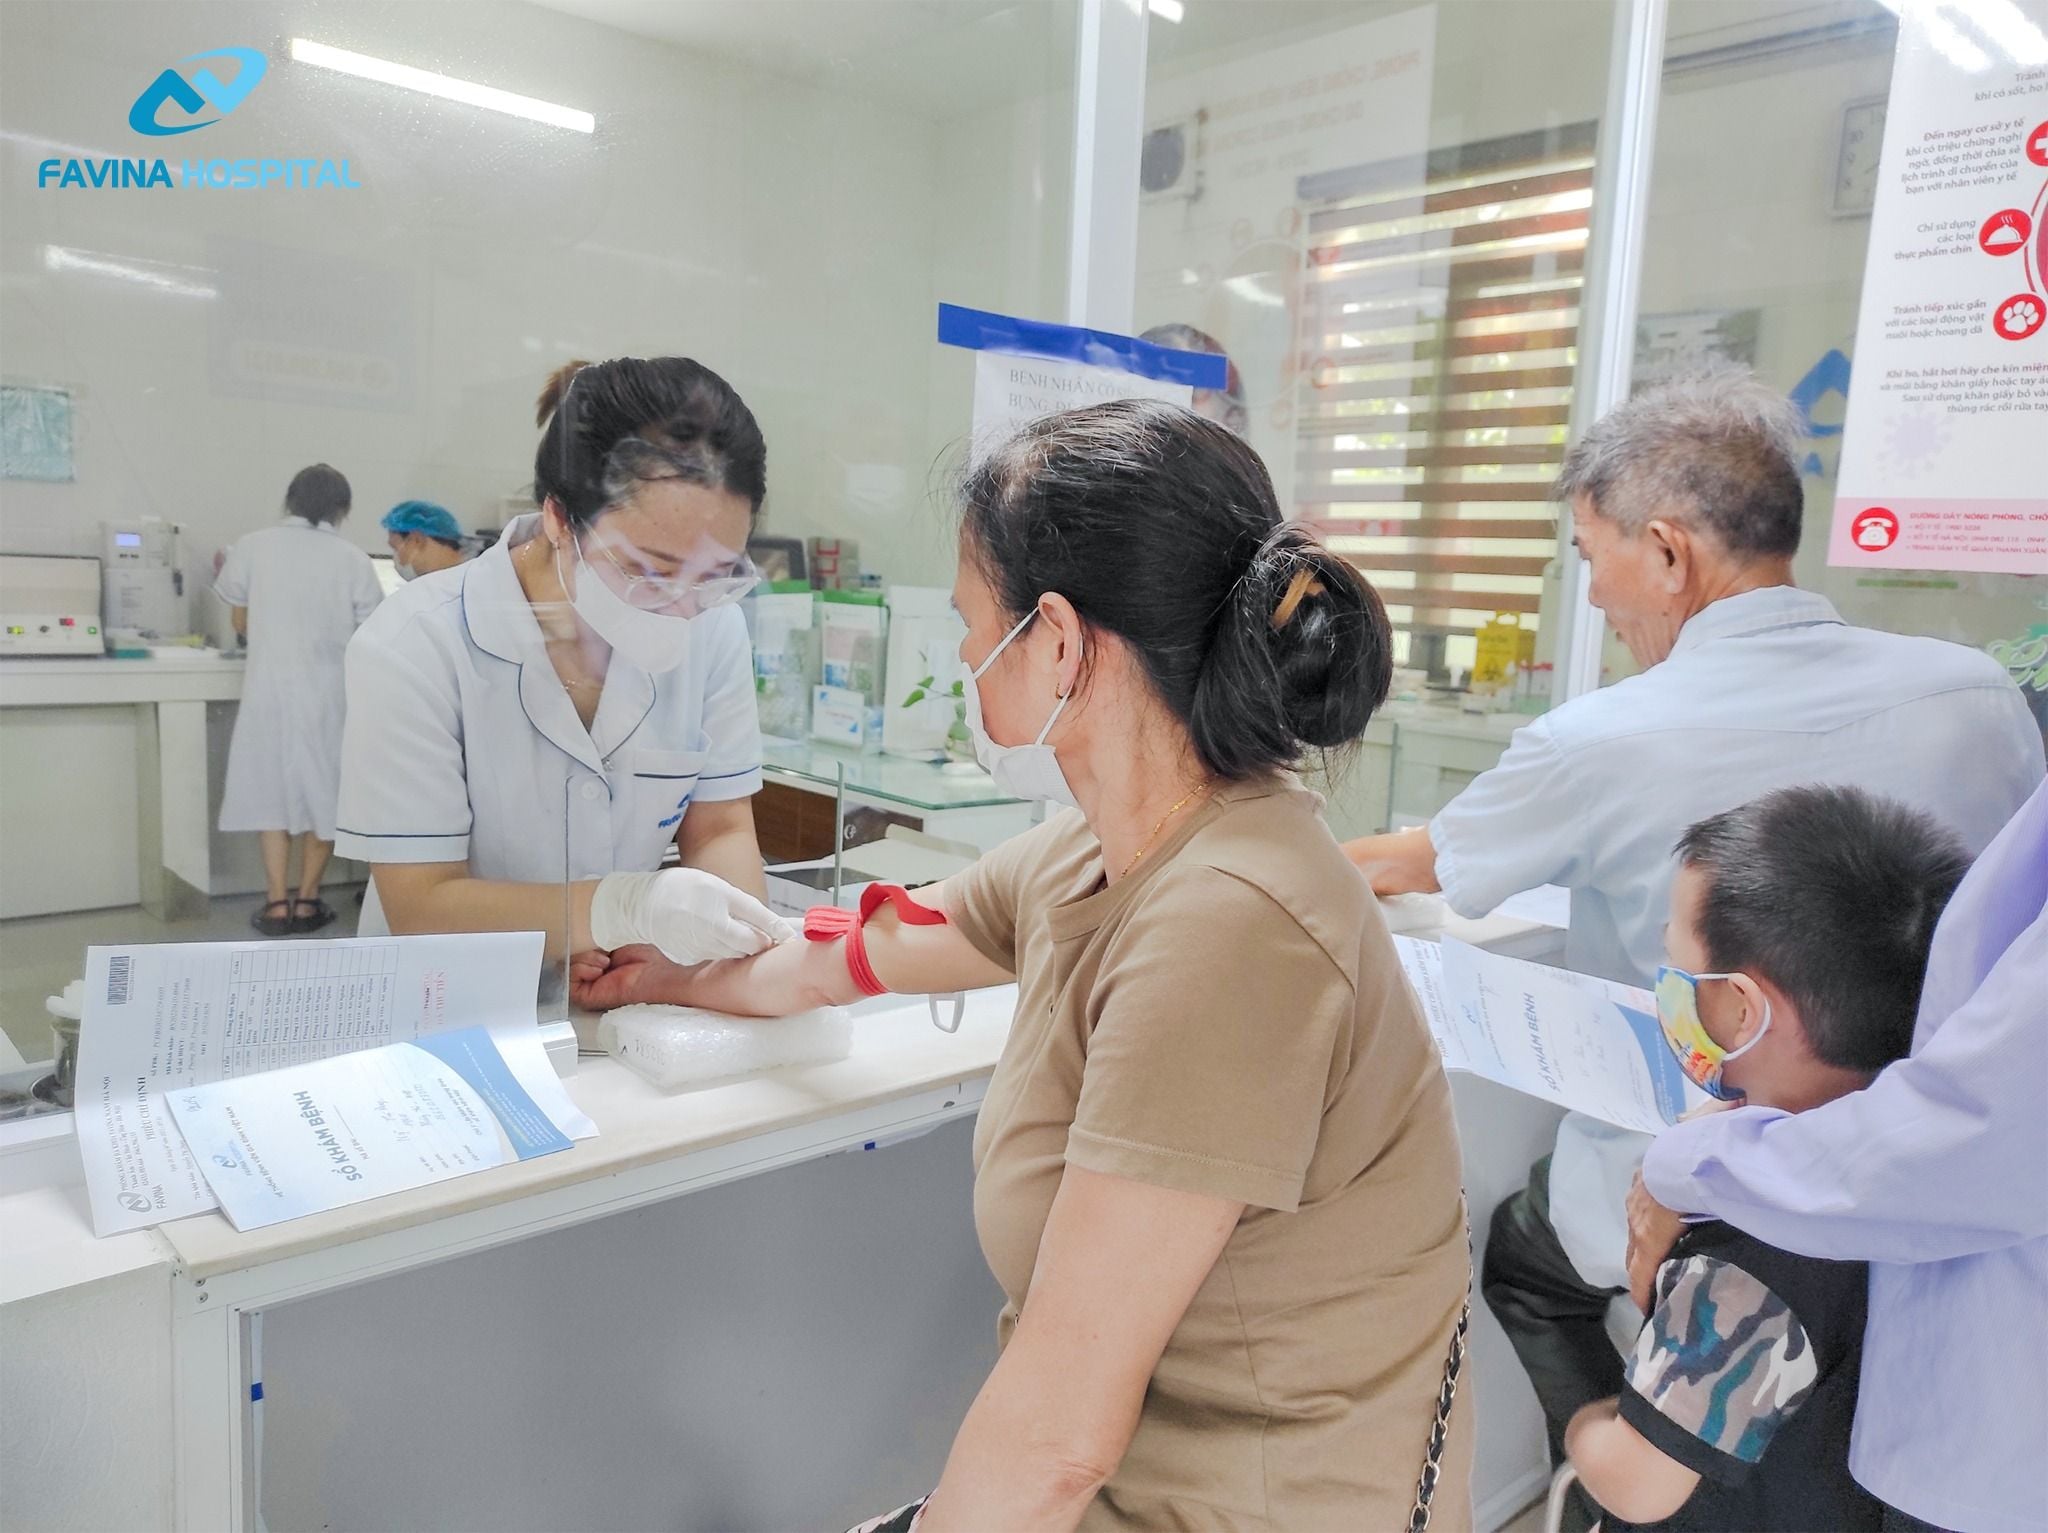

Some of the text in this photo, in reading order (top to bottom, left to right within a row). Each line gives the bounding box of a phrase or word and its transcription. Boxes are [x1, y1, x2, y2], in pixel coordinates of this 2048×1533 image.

[1975, 92, 1992, 101] khi
[1993, 89, 2005, 98] có
[2029, 84, 2043, 93] ho
[1924, 130, 1944, 141] Đến
[1947, 128, 1972, 139] ngay
[1976, 125, 1989, 133] cơ
[1990, 122, 2003, 131] sở
[2014, 116, 2025, 127] tế
[1906, 133, 2022, 156] khi có triệu chứng nghi
[1933, 155, 1959, 166] đồng
[1962, 151, 1982, 160] thời
[1985, 147, 2006, 158] chia
[2009, 145, 2020, 154] sẻ
[1902, 159, 2018, 183] lịch trình di chuyển của
[1906, 172, 2017, 195] bạn với nhân viên y tế
[1917, 219, 1976, 233] Chỉ sử dụng
[1937, 233, 1974, 243] các loại
[1895, 245, 1972, 260] thực phẩm chín
[1894, 300, 1986, 315] Tránh tiếp xúc gần
[1902, 317, 1917, 326] các
[1920, 316, 1937, 325] loại
[1940, 314, 1966, 325] động
[1969, 312, 1985, 321] vật
[1910, 328, 1933, 339] hoặc
[1936, 327, 1967, 338] hoang
[1941, 367, 1957, 376] hơi
[1960, 366, 1978, 376] hãy
[1982, 364, 2000, 374] che
[2003, 364, 2019, 373] kín
[1941, 379, 1965, 389] khăn
[1968, 378, 1988, 390] giấy
[1992, 378, 2017, 387] hoặc
[2021, 375, 2039, 386] tay
[1902, 393, 1920, 402] Sau
[1923, 392, 1934, 401] sử
[1936, 392, 1962, 402] dụng
[1965, 391, 1990, 400] khăn
[1993, 390, 2014, 401] giấy
[2017, 389, 2031, 397] bỏ
[1947, 404, 1977, 414] thùng
[1980, 403, 1994, 412] rác
[1997, 402, 2012, 411] rồi
[2014, 401, 2031, 410] rửa
[1964, 512, 1989, 520] NÓNG
[1524, 992, 1540, 1031] BỆNH
[1530, 1034, 1550, 1073] KHÁM
[136, 1077, 149, 1102] ĐỊNH
[1537, 1072, 1560, 1092] SỔ
[293, 1090, 363, 1181] SỔ KHÁM BỆNH
[152, 1184, 167, 1209] FAVINA
